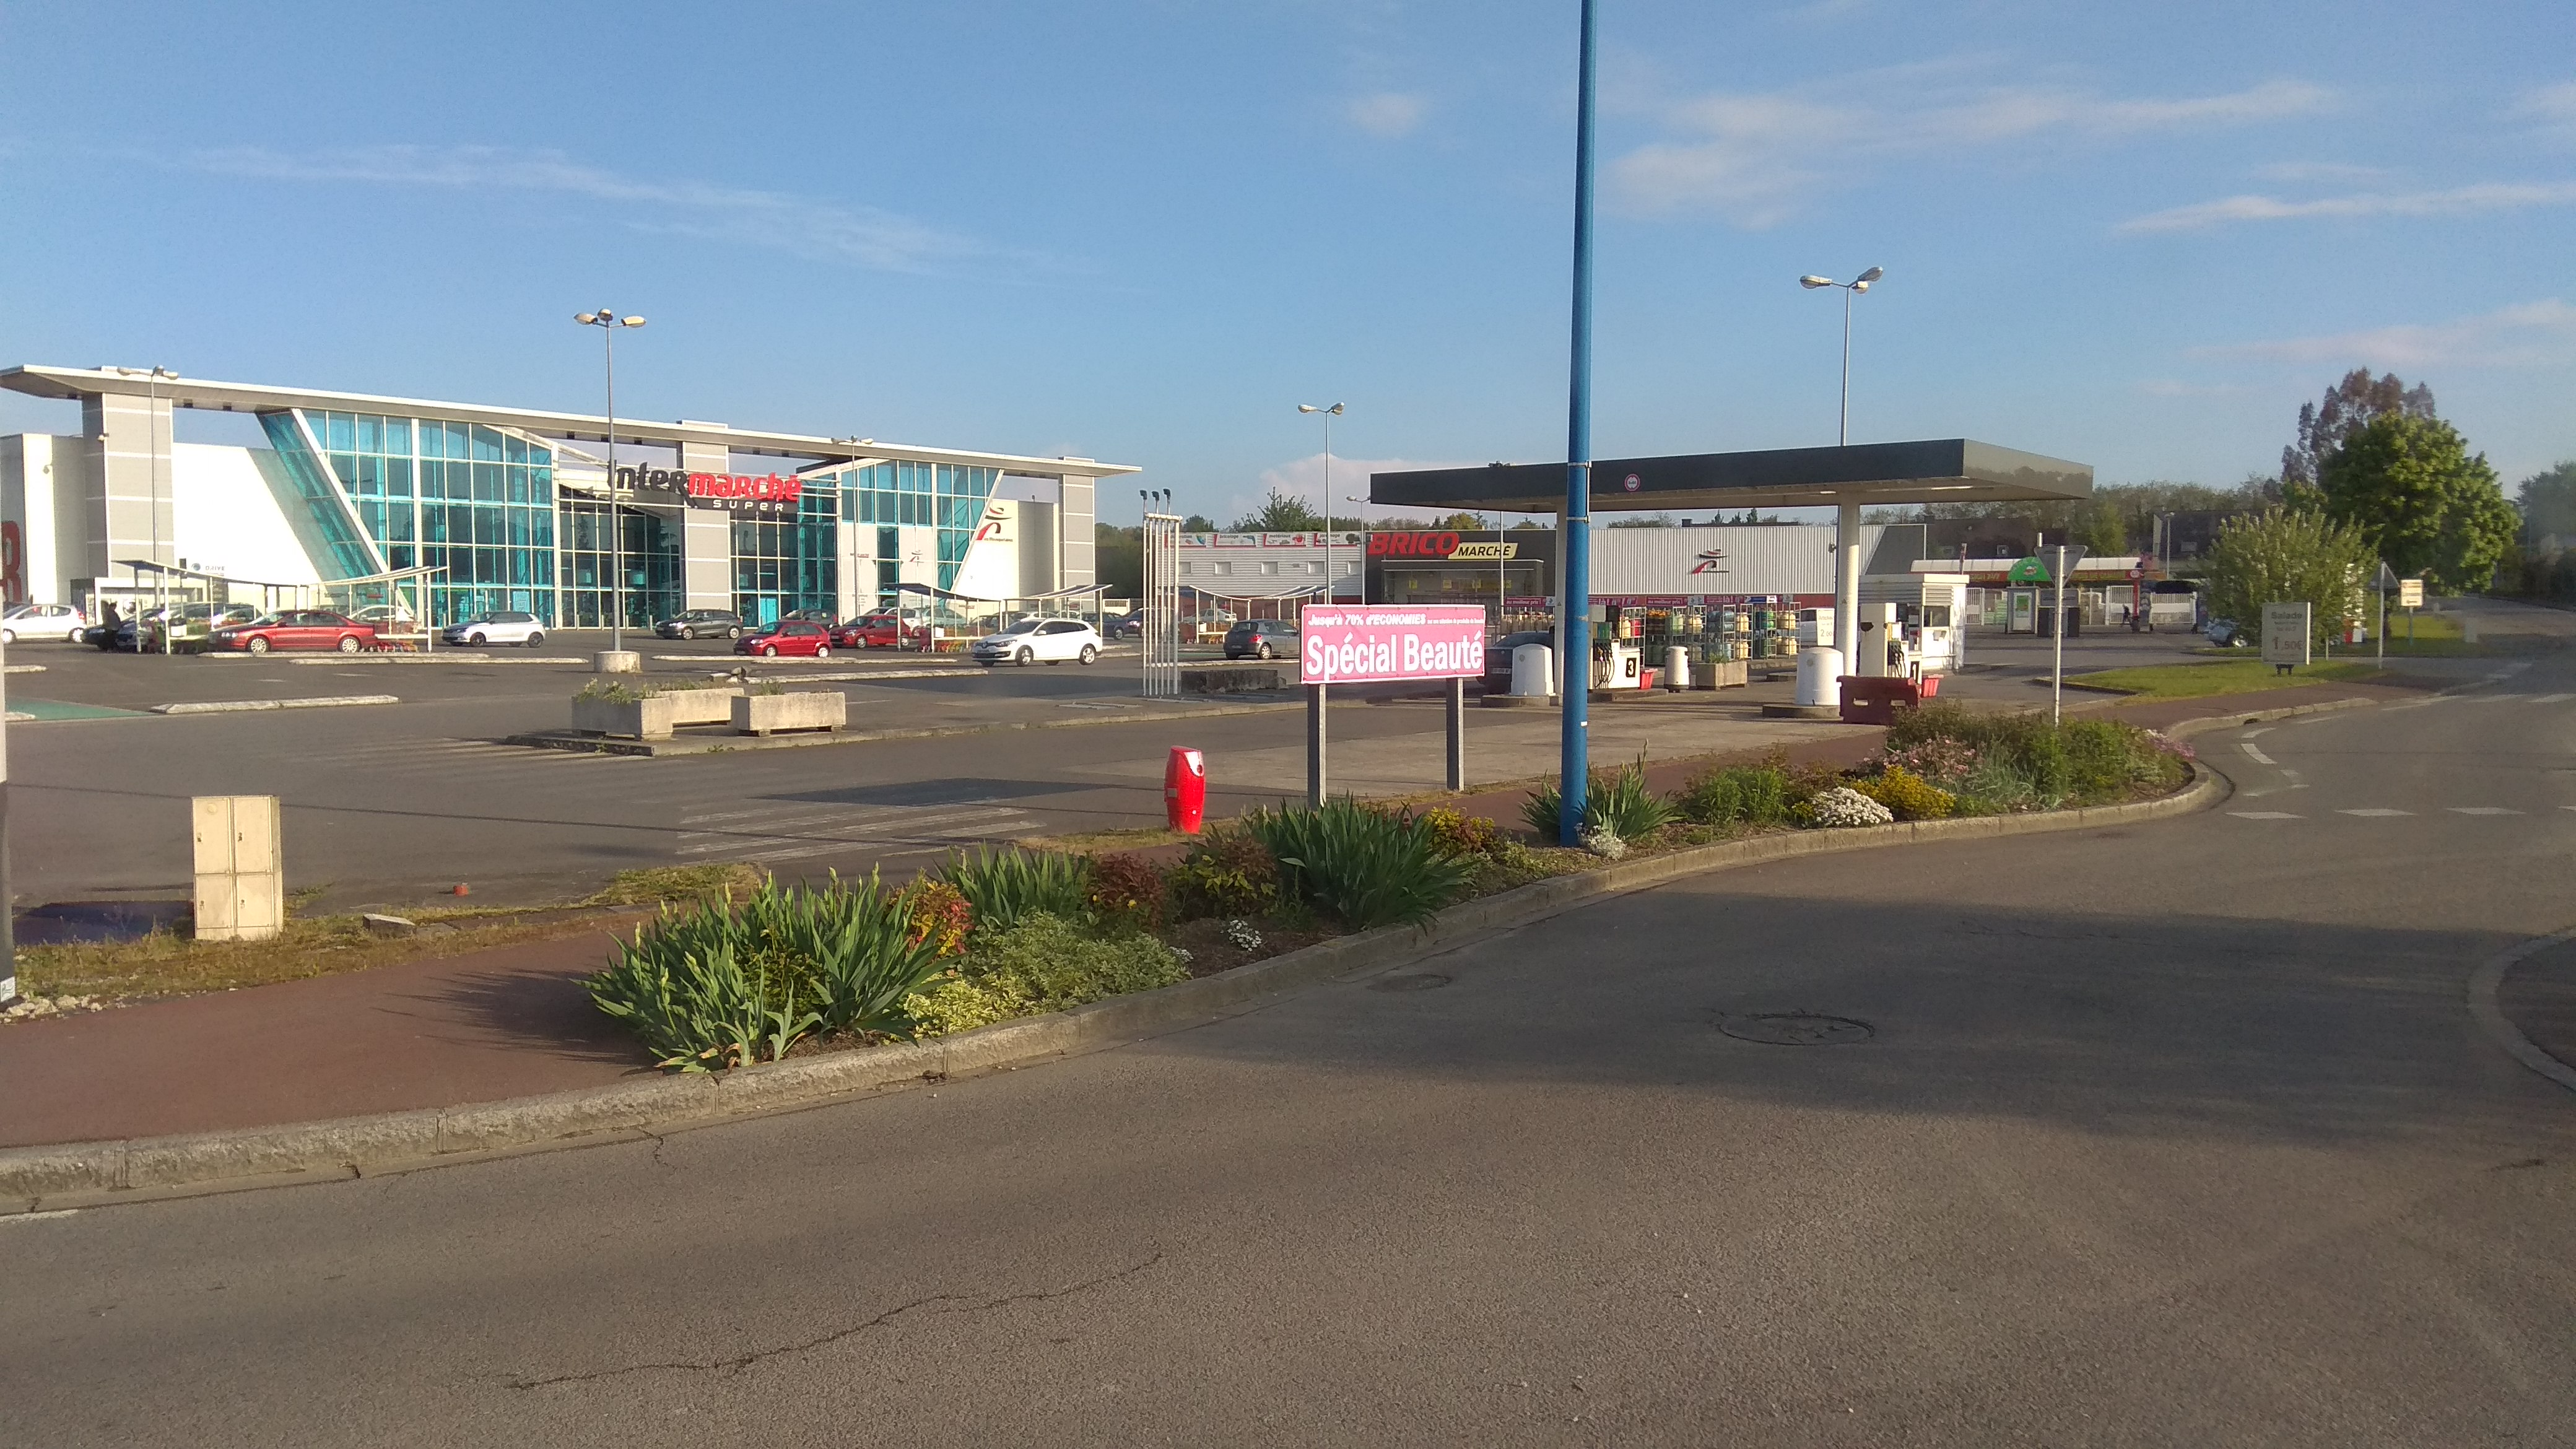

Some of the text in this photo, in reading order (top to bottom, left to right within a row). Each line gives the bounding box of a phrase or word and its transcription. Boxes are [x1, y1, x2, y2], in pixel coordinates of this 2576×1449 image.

[712, 499, 784, 512] SUPER
[1366, 531, 1460, 555] BRICO
[1458, 545, 1511, 556] MARCHÉ
[1308, 614, 1343, 628] Jusqu'à
[1344, 614, 1364, 626] 70%
[2271, 611, 2303, 619] Salade
[1305, 630, 1483, 681] Spécial Beauté
[1627, 659, 1634, 676] 3
[1912, 664, 1917, 681] 1
